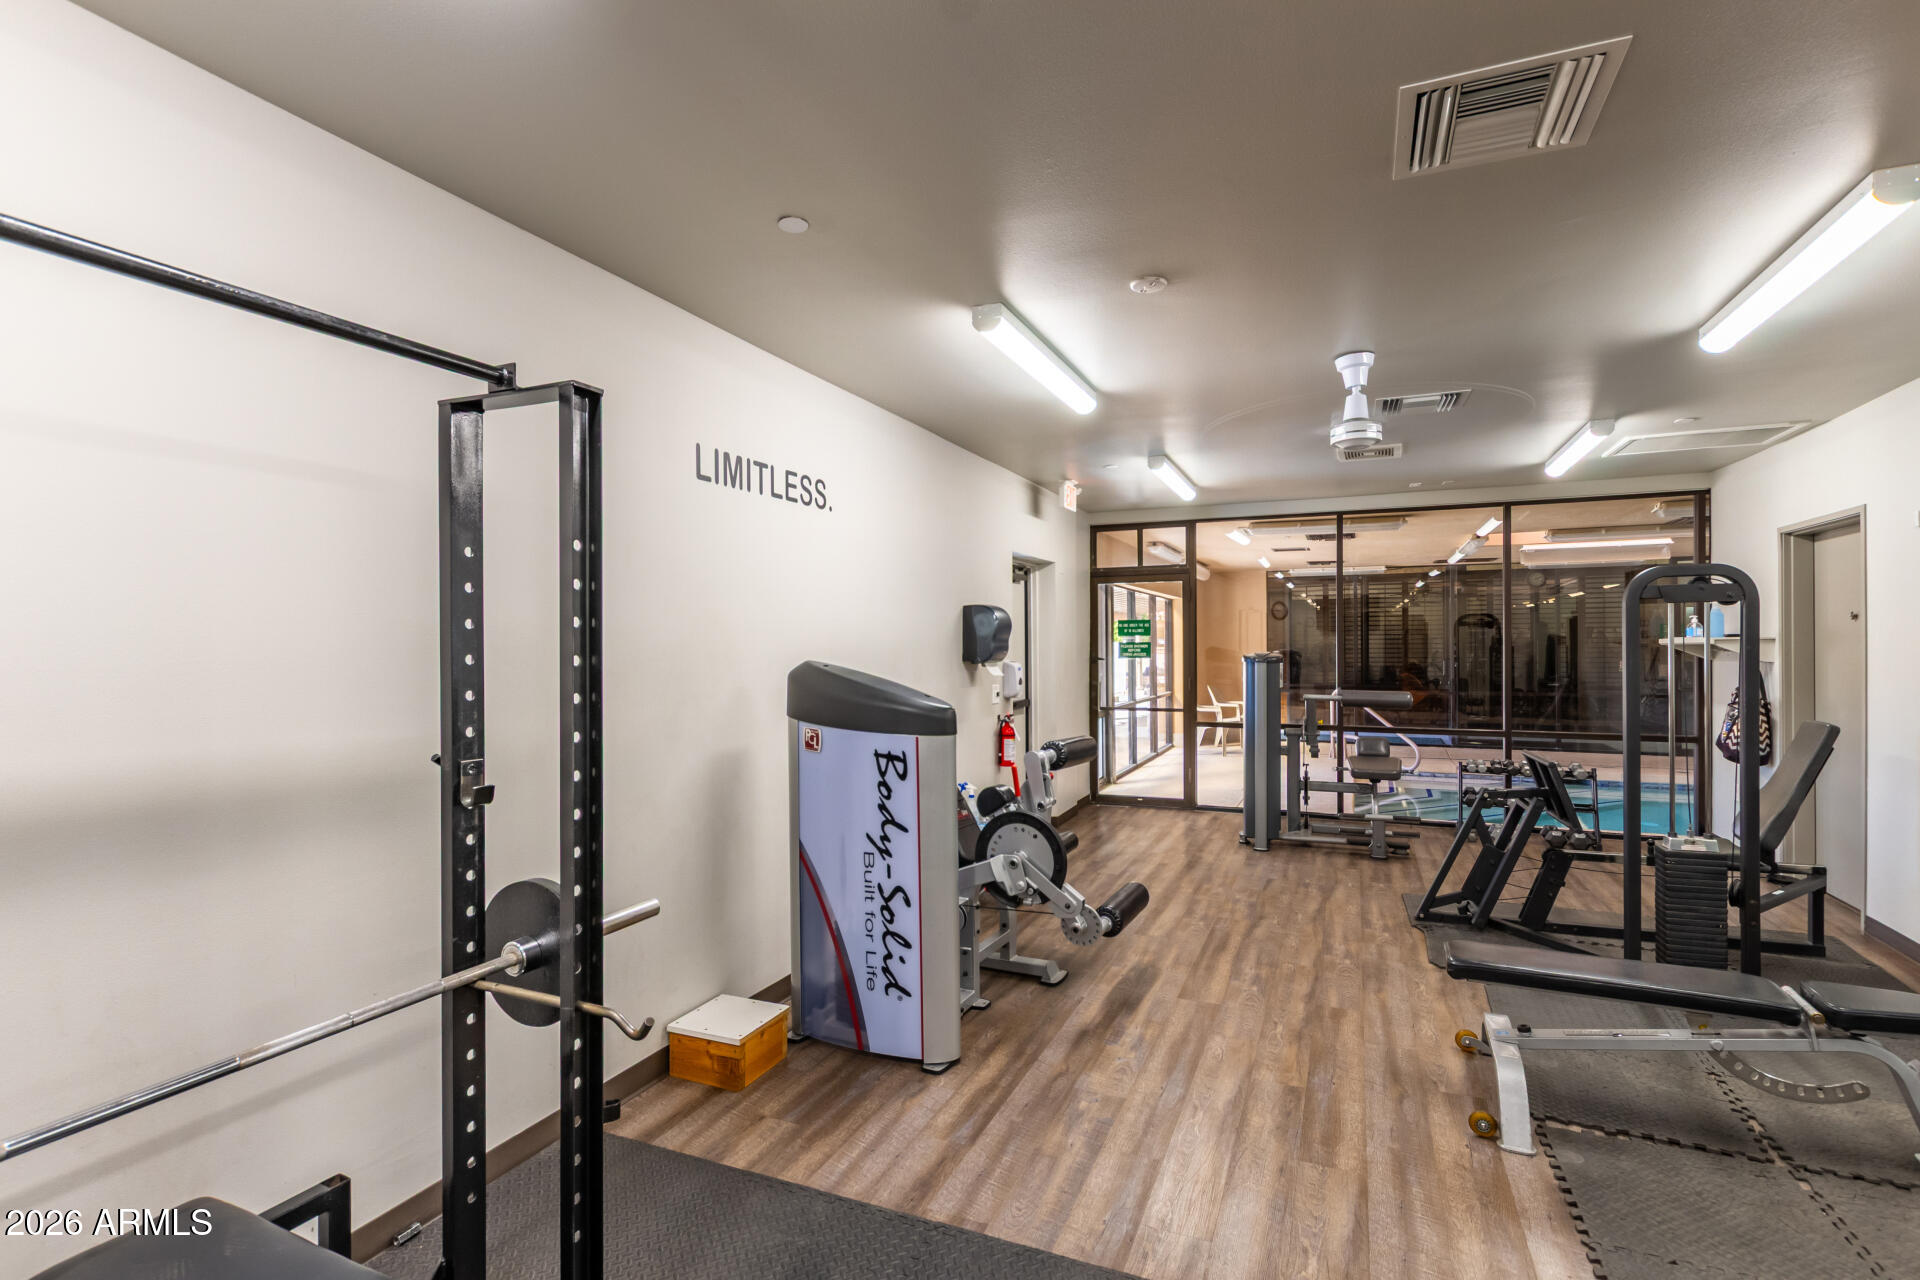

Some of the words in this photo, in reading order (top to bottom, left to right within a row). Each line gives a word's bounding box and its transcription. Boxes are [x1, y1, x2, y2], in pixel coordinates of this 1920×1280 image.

[695, 442, 833, 512] LIMITLESS.
[863, 851, 876, 903] Built
[866, 749, 912, 998] Body-Solid
[865, 911, 876, 943] for
[865, 951, 877, 992] Life
